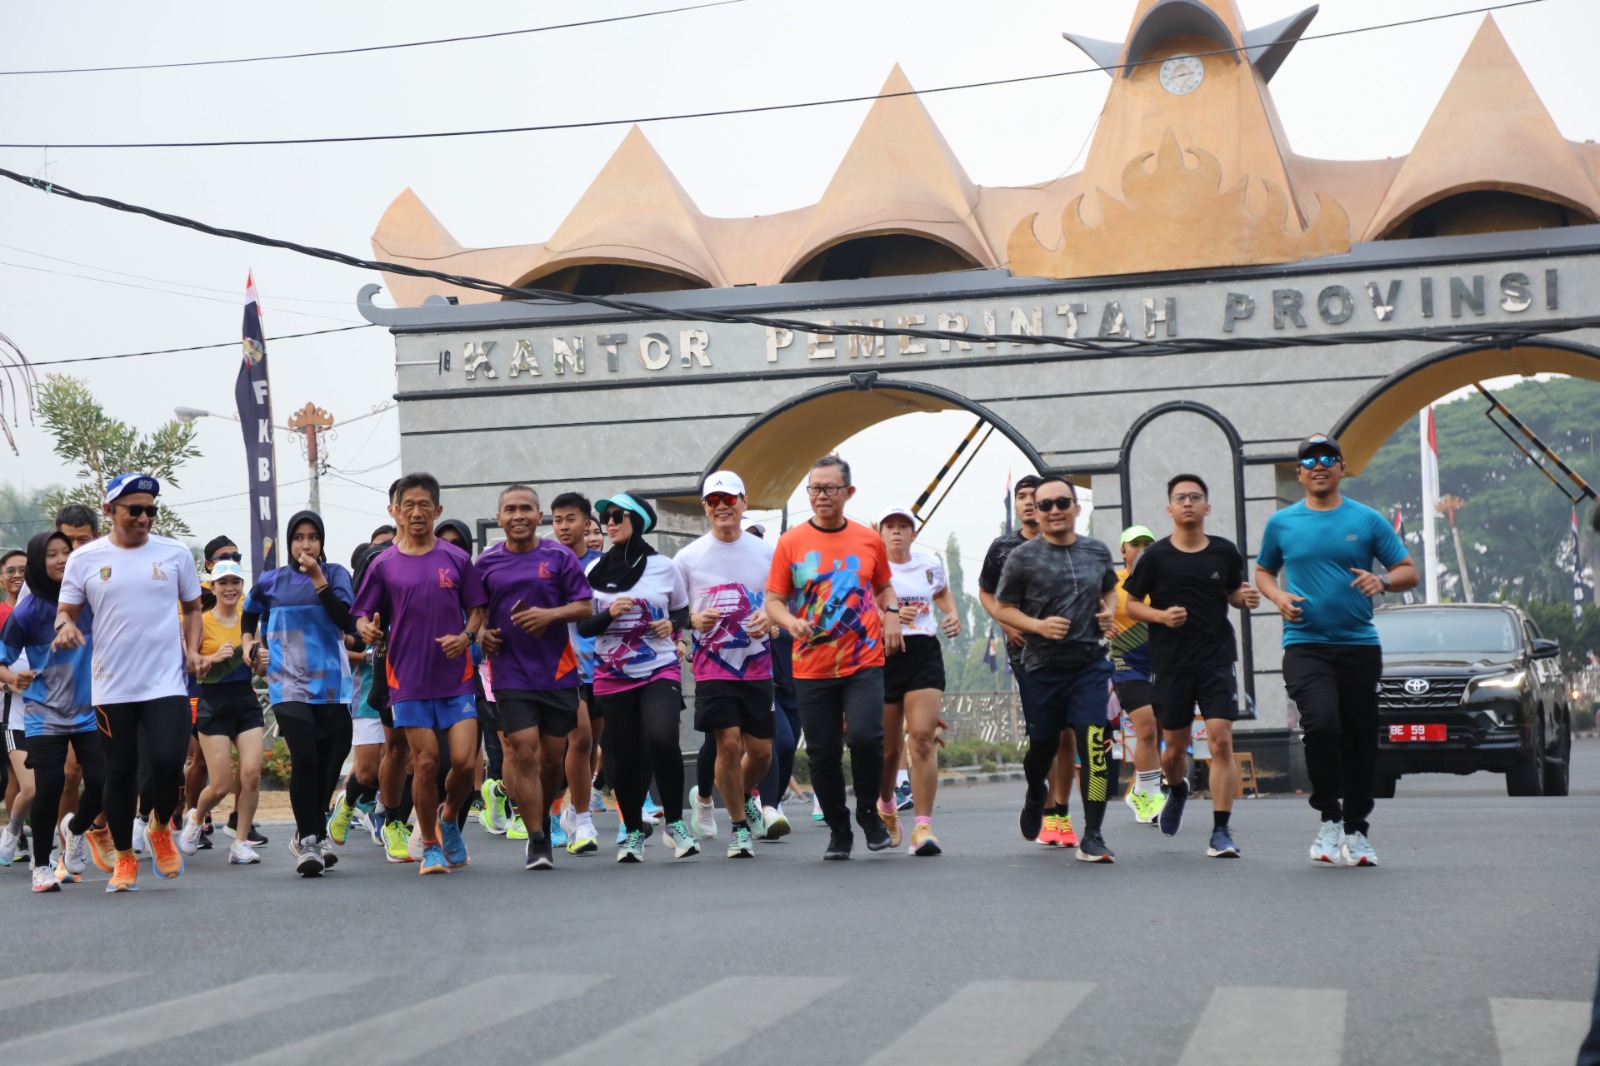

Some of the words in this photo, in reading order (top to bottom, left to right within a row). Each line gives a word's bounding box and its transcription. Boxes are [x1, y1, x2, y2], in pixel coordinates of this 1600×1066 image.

[463, 329, 713, 381] KANTOR
[765, 297, 1178, 363] PEMERINTAH
[1222, 268, 1560, 333] PROVINSI
[252, 379, 272, 521] FKBN
[1390, 725, 1404, 734] BE
[1411, 725, 1425, 735] 59
